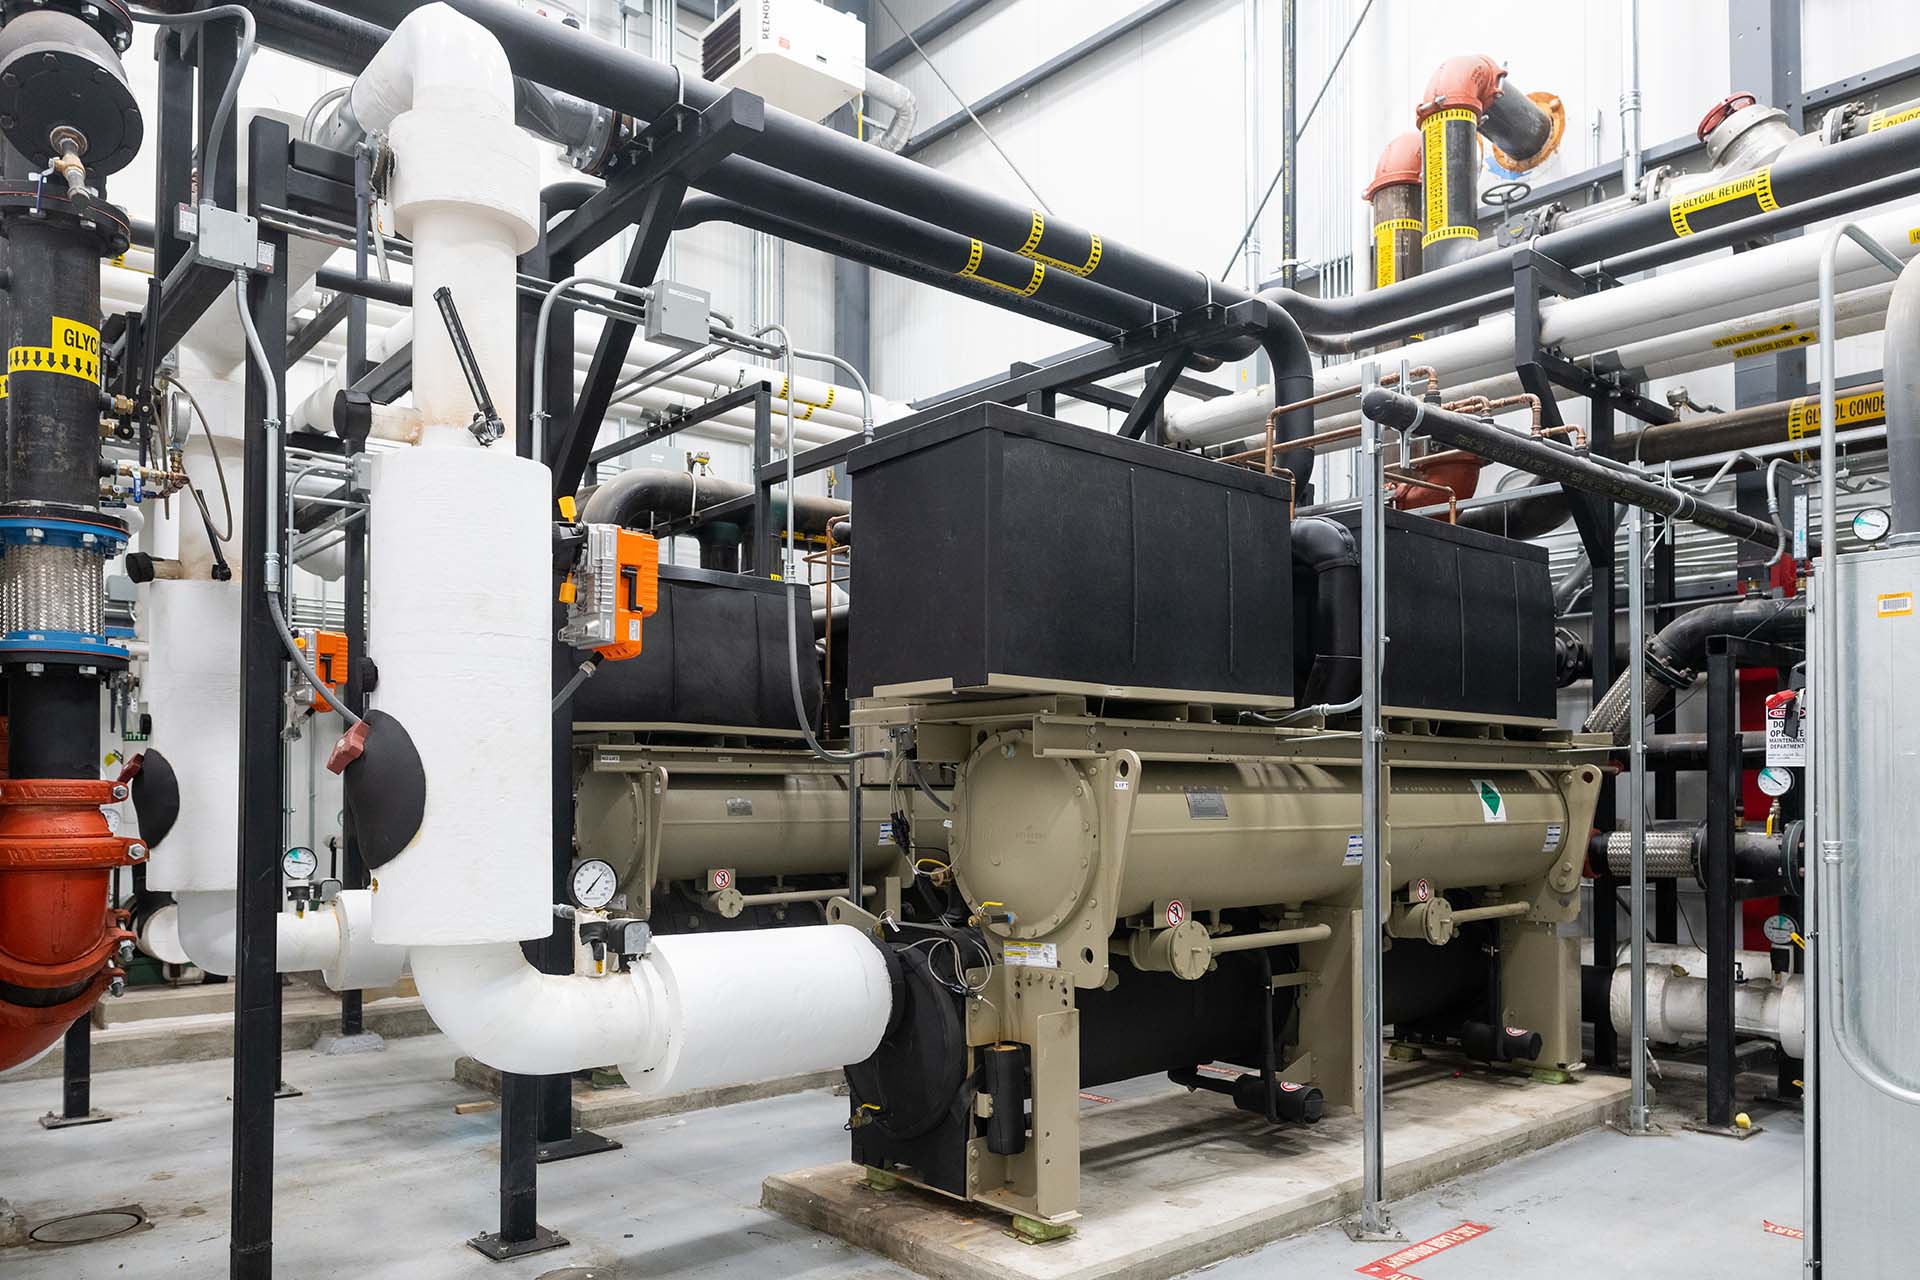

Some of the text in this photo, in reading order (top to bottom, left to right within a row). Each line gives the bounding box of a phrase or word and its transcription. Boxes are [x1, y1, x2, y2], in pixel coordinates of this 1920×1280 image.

[1430, 152, 1442, 199] CONDENSER
[1683, 178, 1755, 208] GLYCOL RETURN
[64, 329, 99, 357] GLYC
